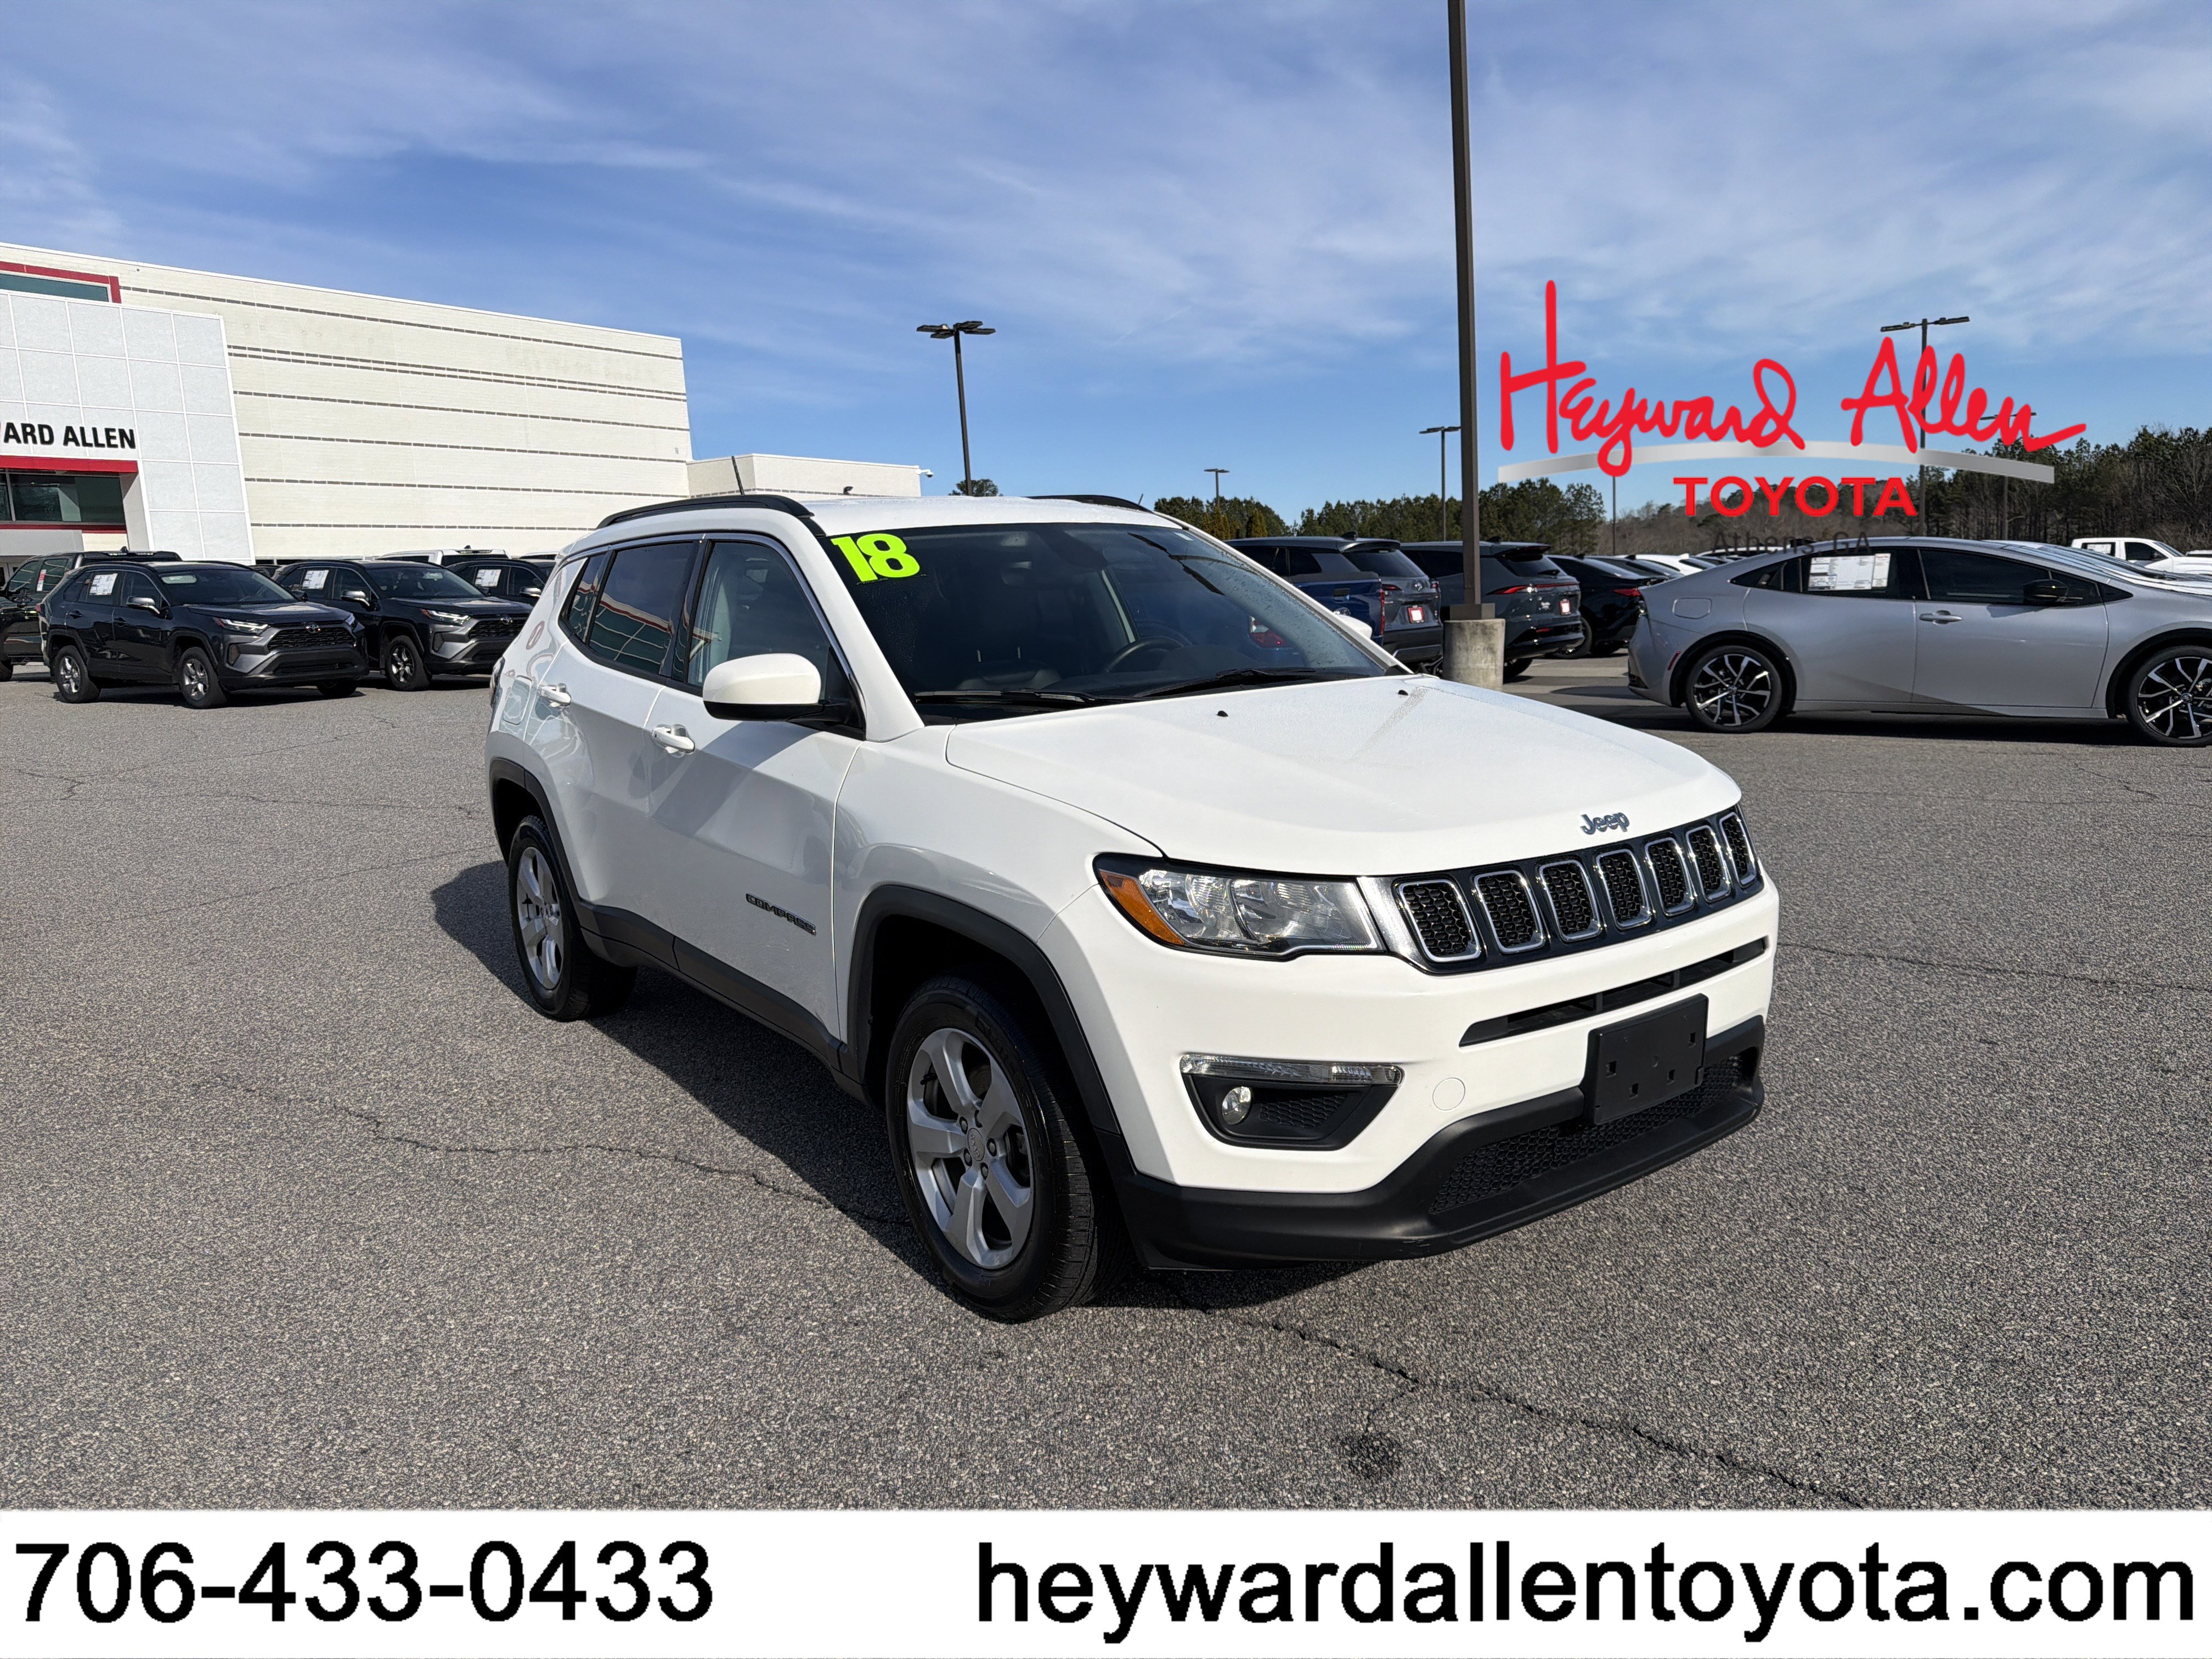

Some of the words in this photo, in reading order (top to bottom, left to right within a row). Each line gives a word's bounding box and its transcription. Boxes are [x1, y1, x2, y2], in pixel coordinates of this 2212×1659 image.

[2, 422, 54, 445] ARD
[63, 425, 136, 449] ALLEN
[831, 533, 920, 582] 18
[1580, 812, 1630, 835] Jeep
[746, 893, 816, 936] COMPASS
